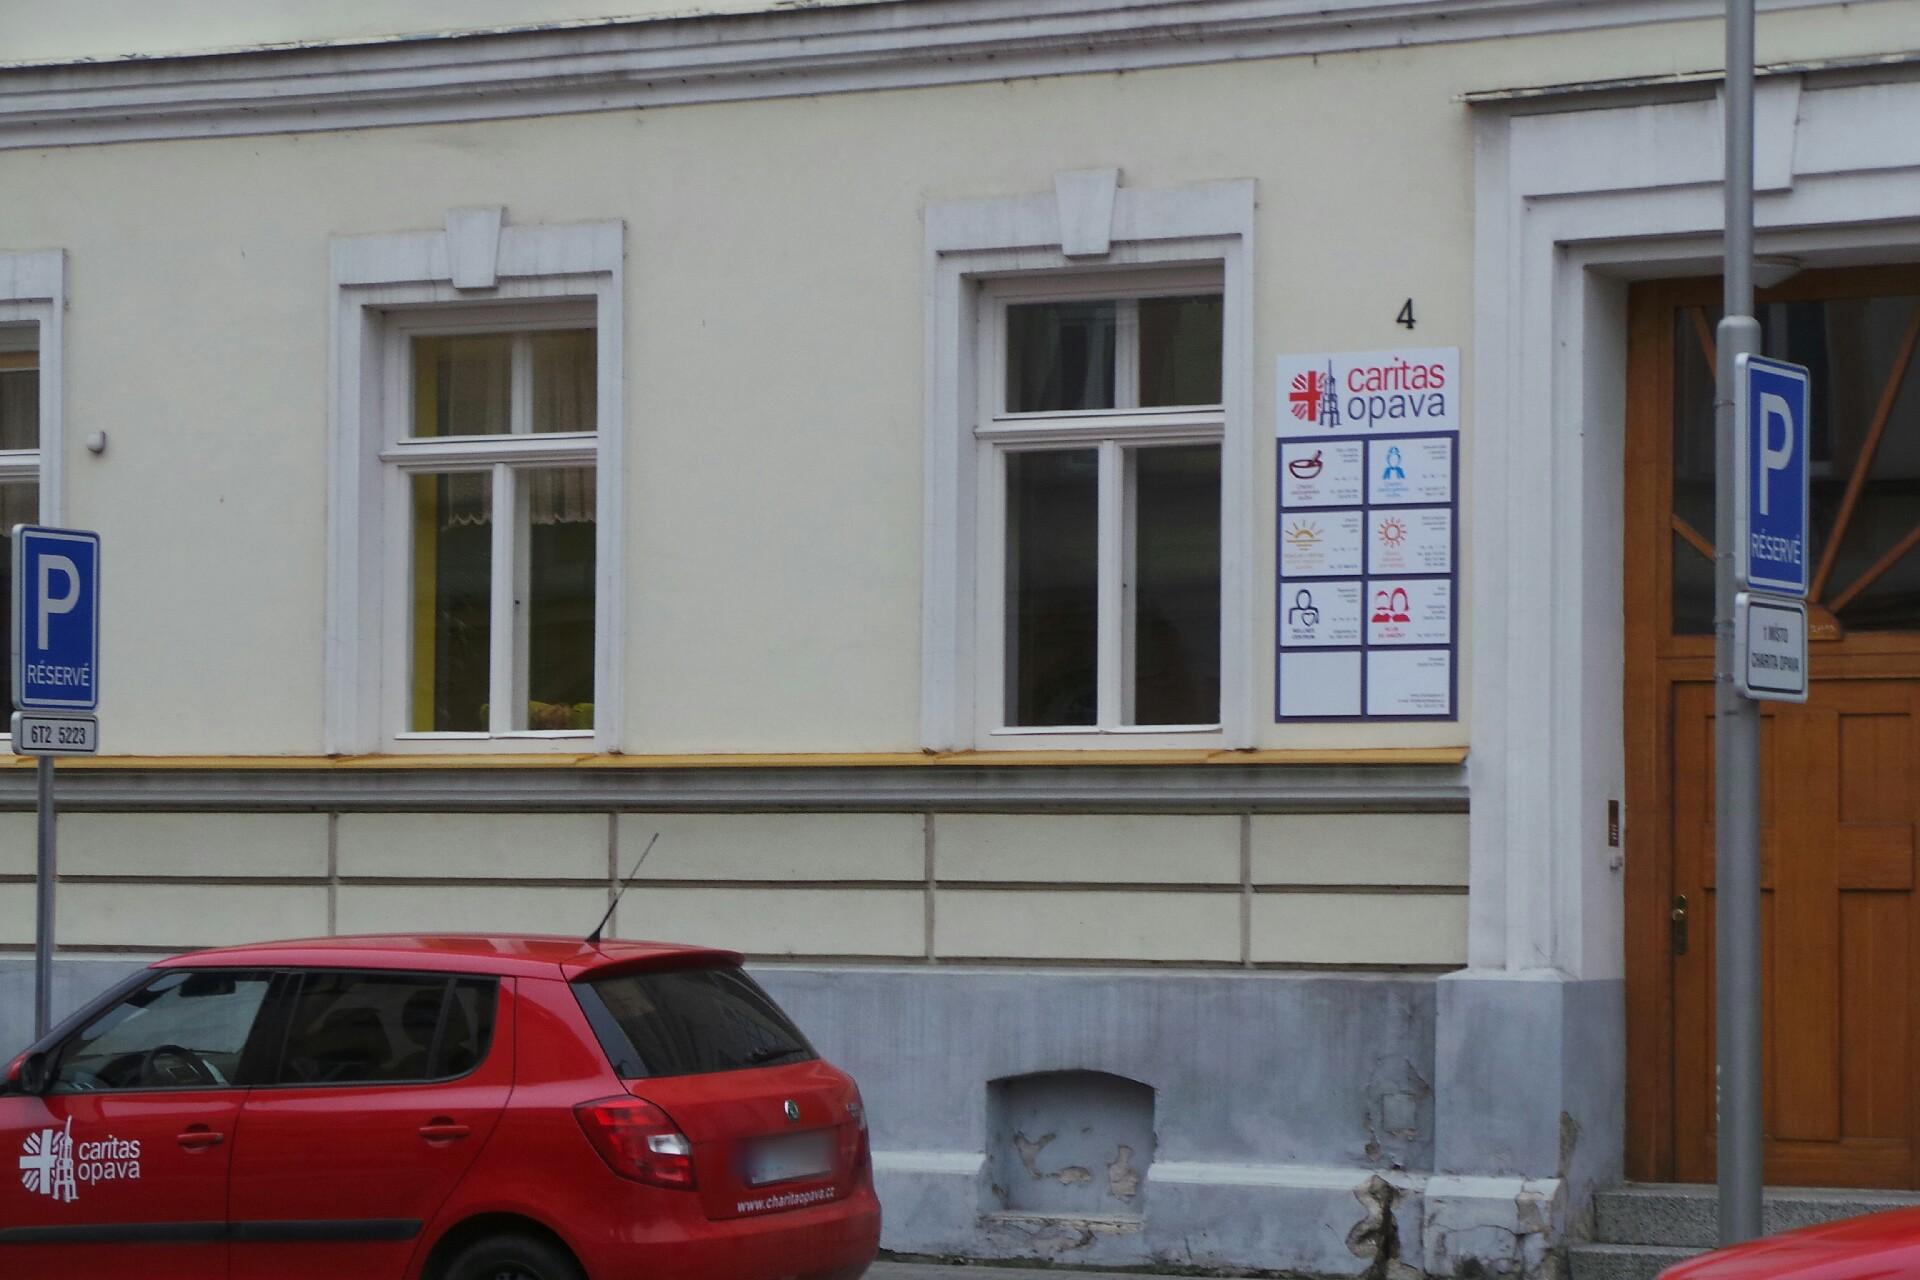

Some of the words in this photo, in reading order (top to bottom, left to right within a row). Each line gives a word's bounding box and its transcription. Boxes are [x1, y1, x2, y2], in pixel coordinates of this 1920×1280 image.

[1396, 297, 1416, 330] 4
[1347, 357, 1446, 393] caritas
[1347, 392, 1446, 428] opava
[1759, 391, 1794, 516] P
[1751, 529, 1801, 565] RÉSERVÉ
[37, 553, 81, 650] P
[27, 660, 90, 687] RÉSERVÉ
[31, 725, 52, 744] 6T2
[59, 727, 86, 745] 5223
[78, 1134, 141, 1161] caritas
[78, 1160, 141, 1186] opava
[737, 1186, 835, 1213] www.charitaopava.cz
